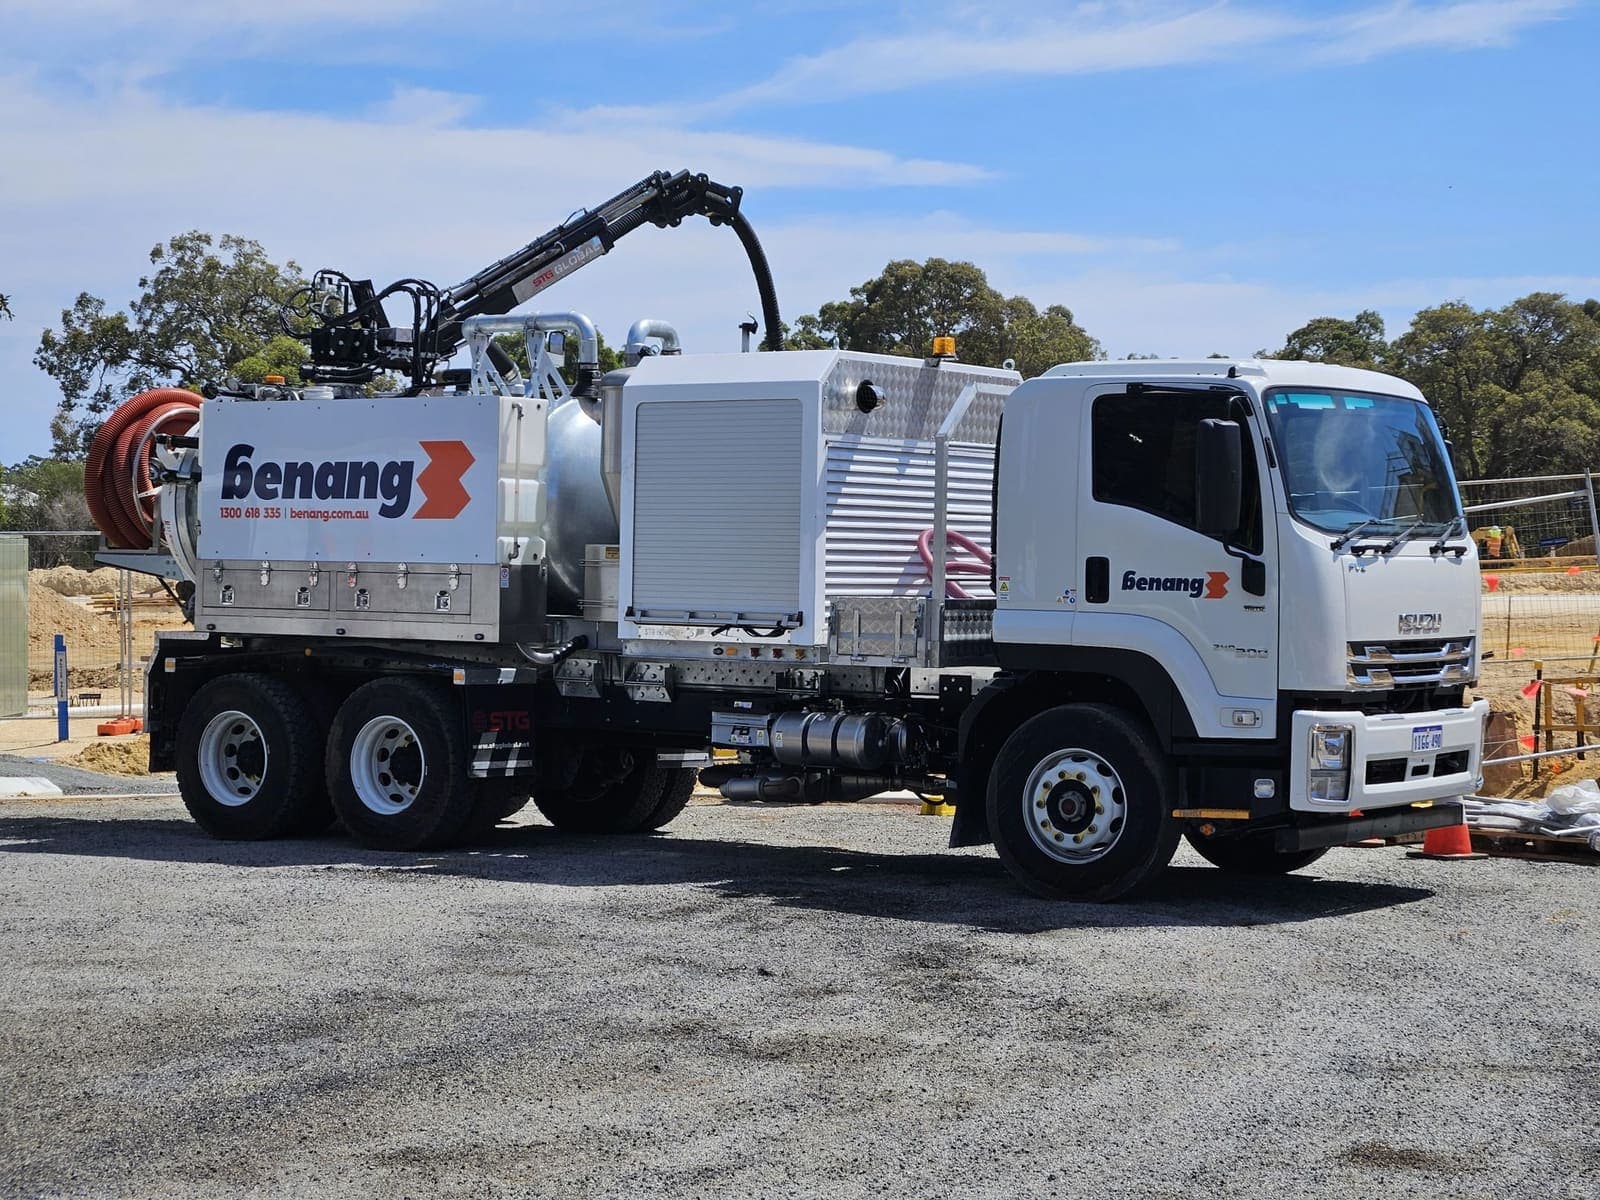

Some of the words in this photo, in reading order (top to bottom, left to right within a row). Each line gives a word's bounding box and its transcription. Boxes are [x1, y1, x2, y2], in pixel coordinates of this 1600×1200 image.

[532, 269, 554, 288] STG
[554, 241, 601, 275] GLOBAL
[221, 443, 415, 519] benang
[220, 507, 242, 519] 1300
[245, 507, 261, 519] 618
[264, 507, 281, 519] 335
[290, 507, 369, 522] benang.com.au
[1121, 570, 1205, 599] benang
[1398, 613, 1442, 634] ISUZU
[489, 710, 530, 731] STG
